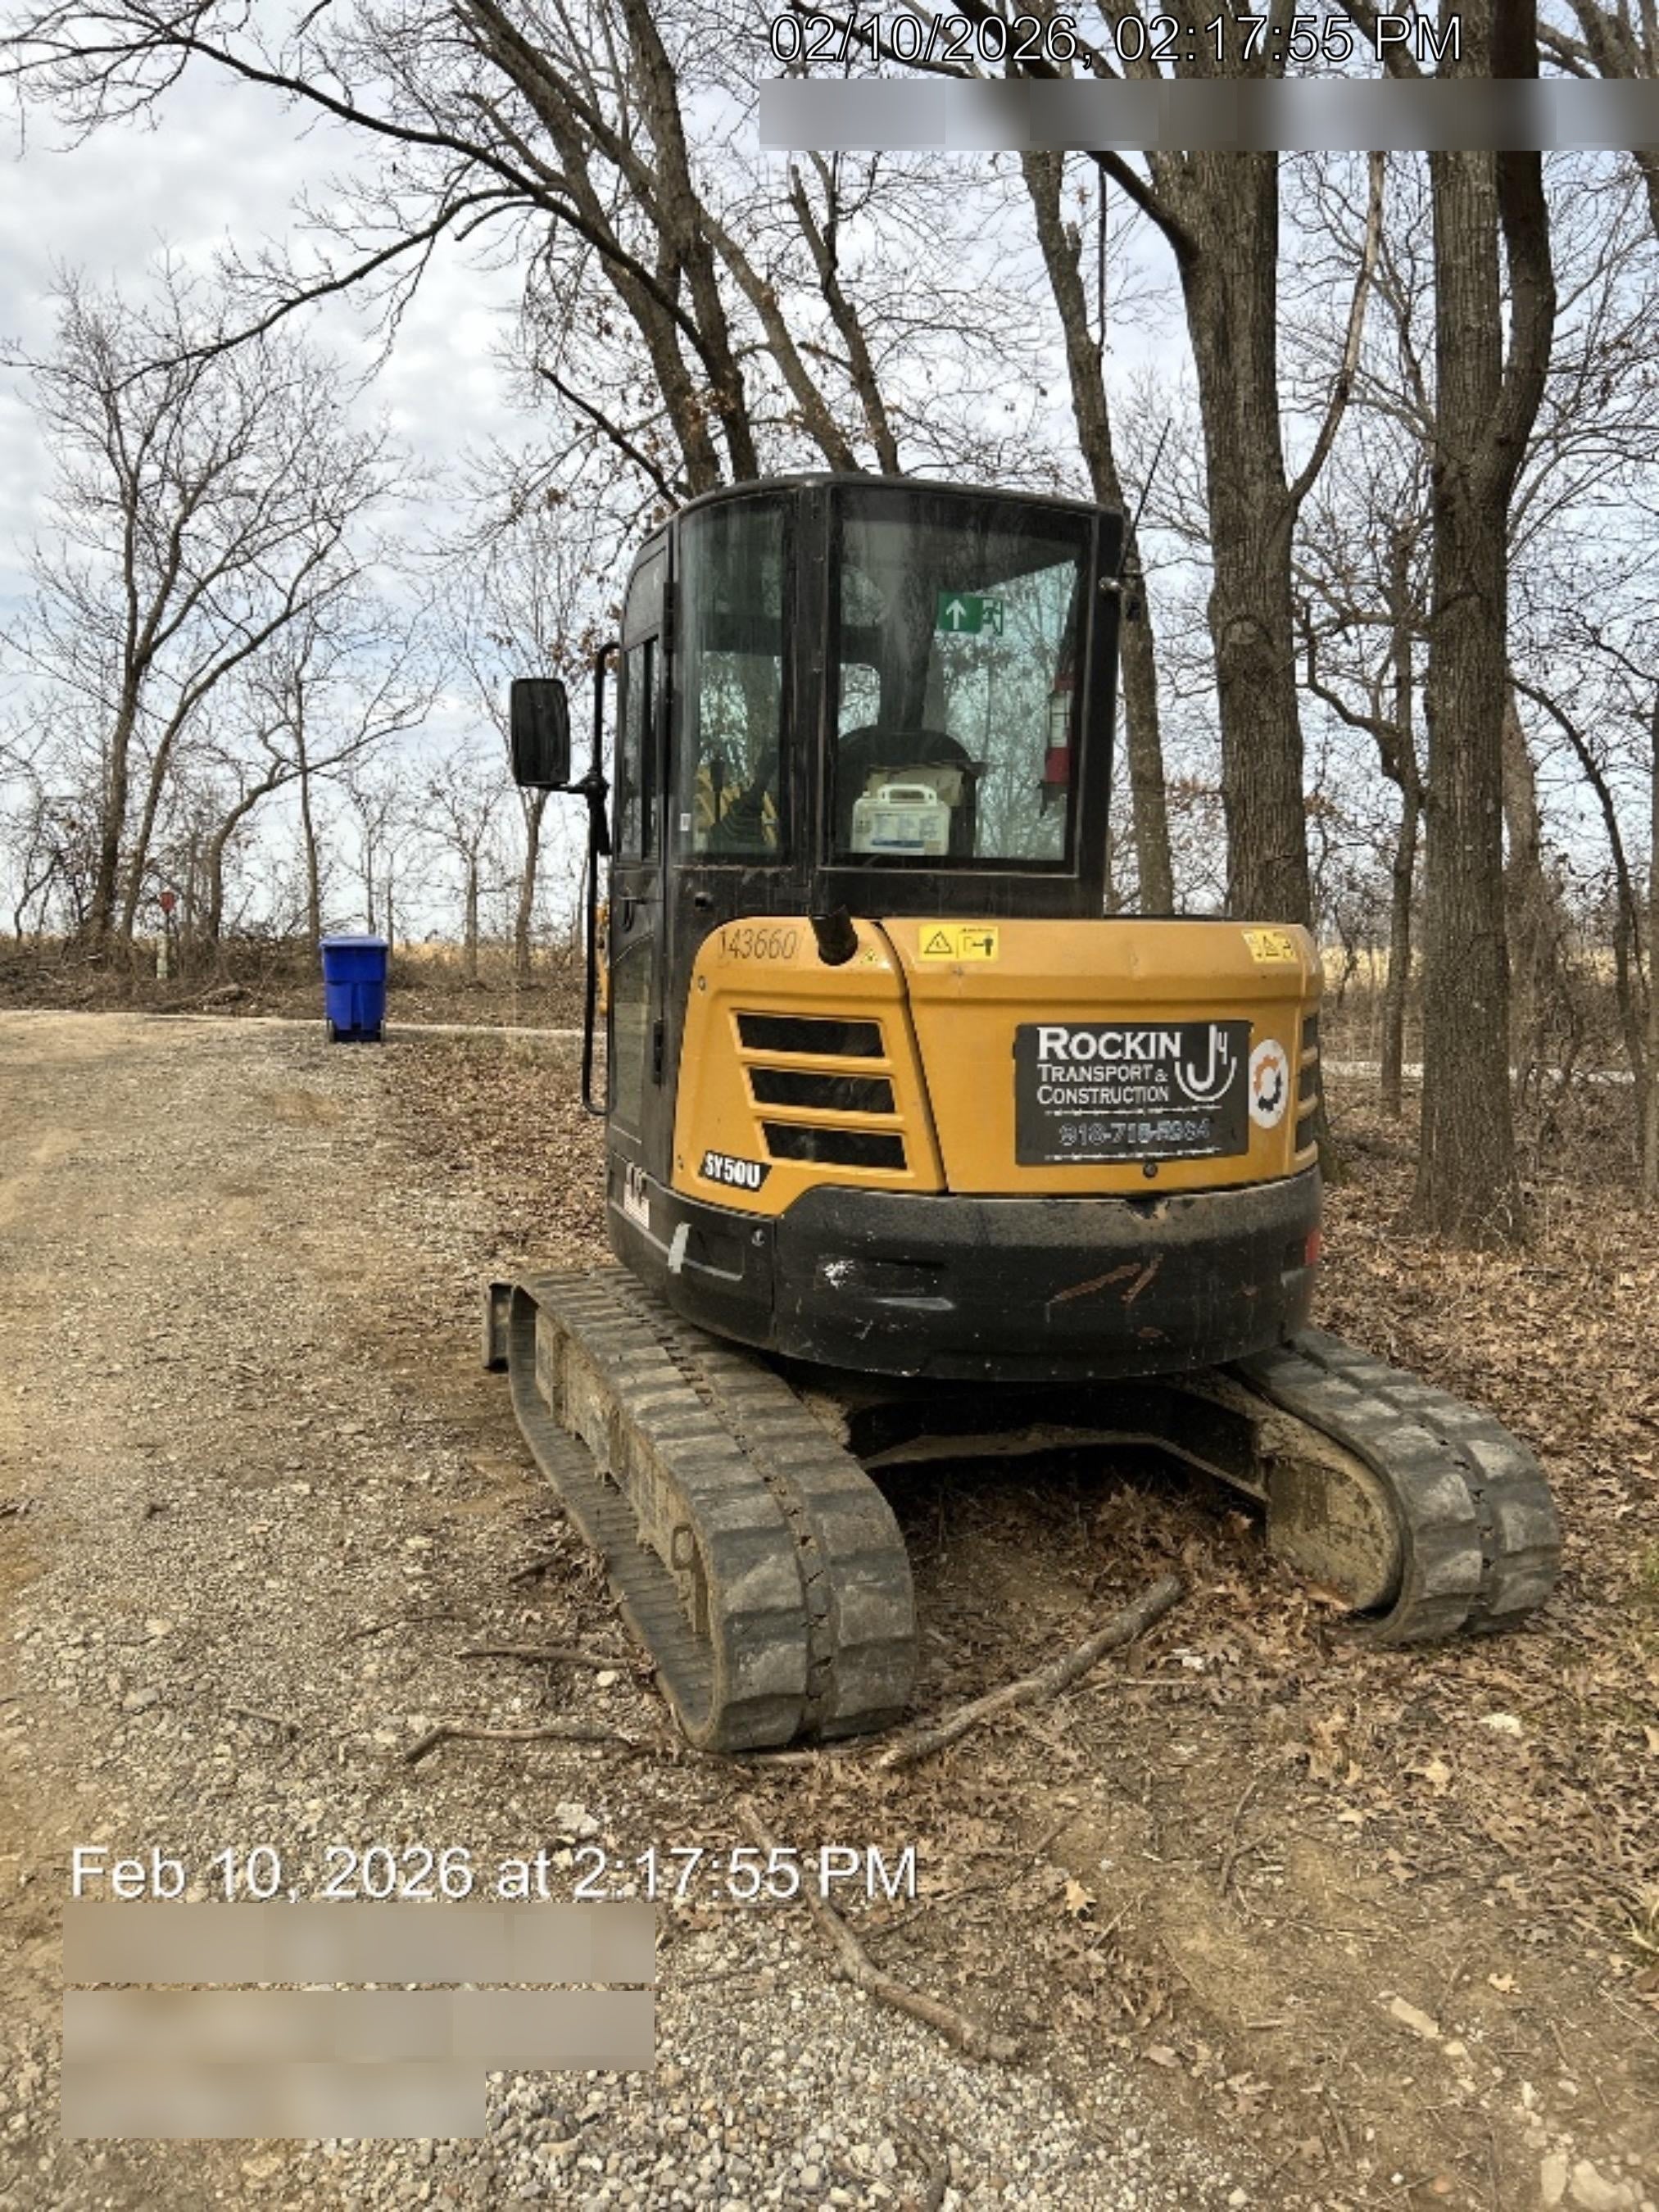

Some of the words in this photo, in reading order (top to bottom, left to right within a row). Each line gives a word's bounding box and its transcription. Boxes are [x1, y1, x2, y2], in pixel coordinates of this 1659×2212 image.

[720, 928, 797, 959] 143660
[1036, 1027, 1182, 1061] ROCKIN
[1036, 1063, 1154, 1083] TRANSPORT
[1154, 1069, 1168, 1083] &
[1036, 1086, 1170, 1105] CONSTRUCTION
[705, 1152, 761, 1188] SY50U
